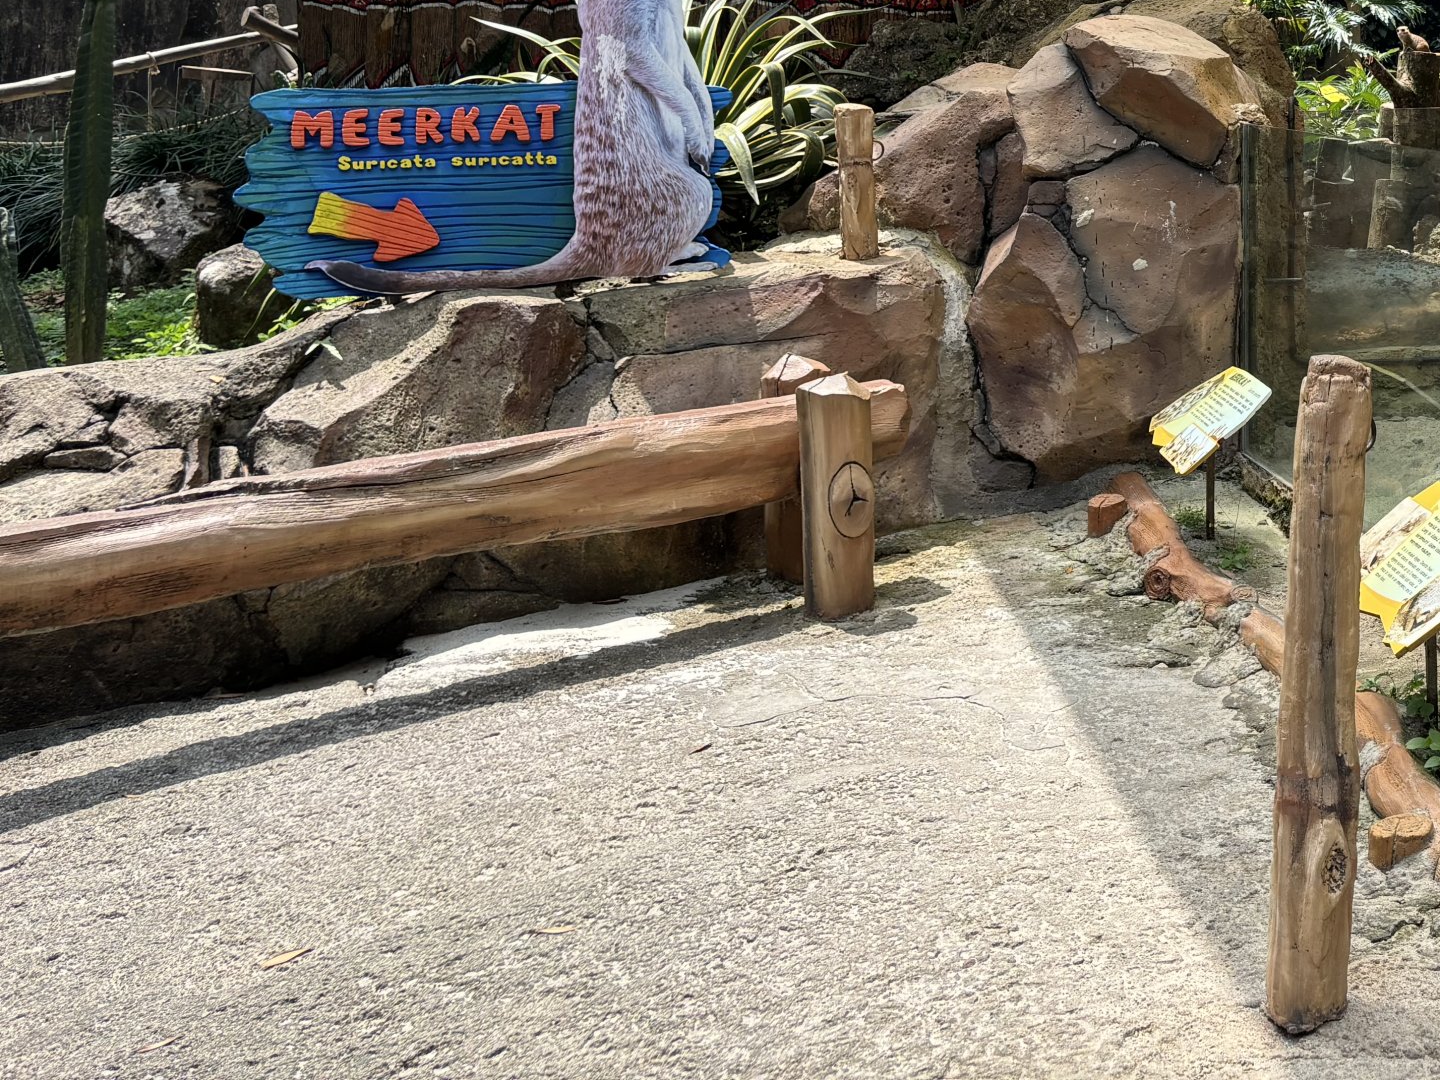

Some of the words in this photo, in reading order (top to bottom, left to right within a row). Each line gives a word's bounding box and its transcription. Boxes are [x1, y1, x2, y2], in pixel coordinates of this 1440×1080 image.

[290, 104, 561, 150] MEERKAT
[338, 155, 437, 171] Suricata
[451, 151, 558, 167] suricatta
